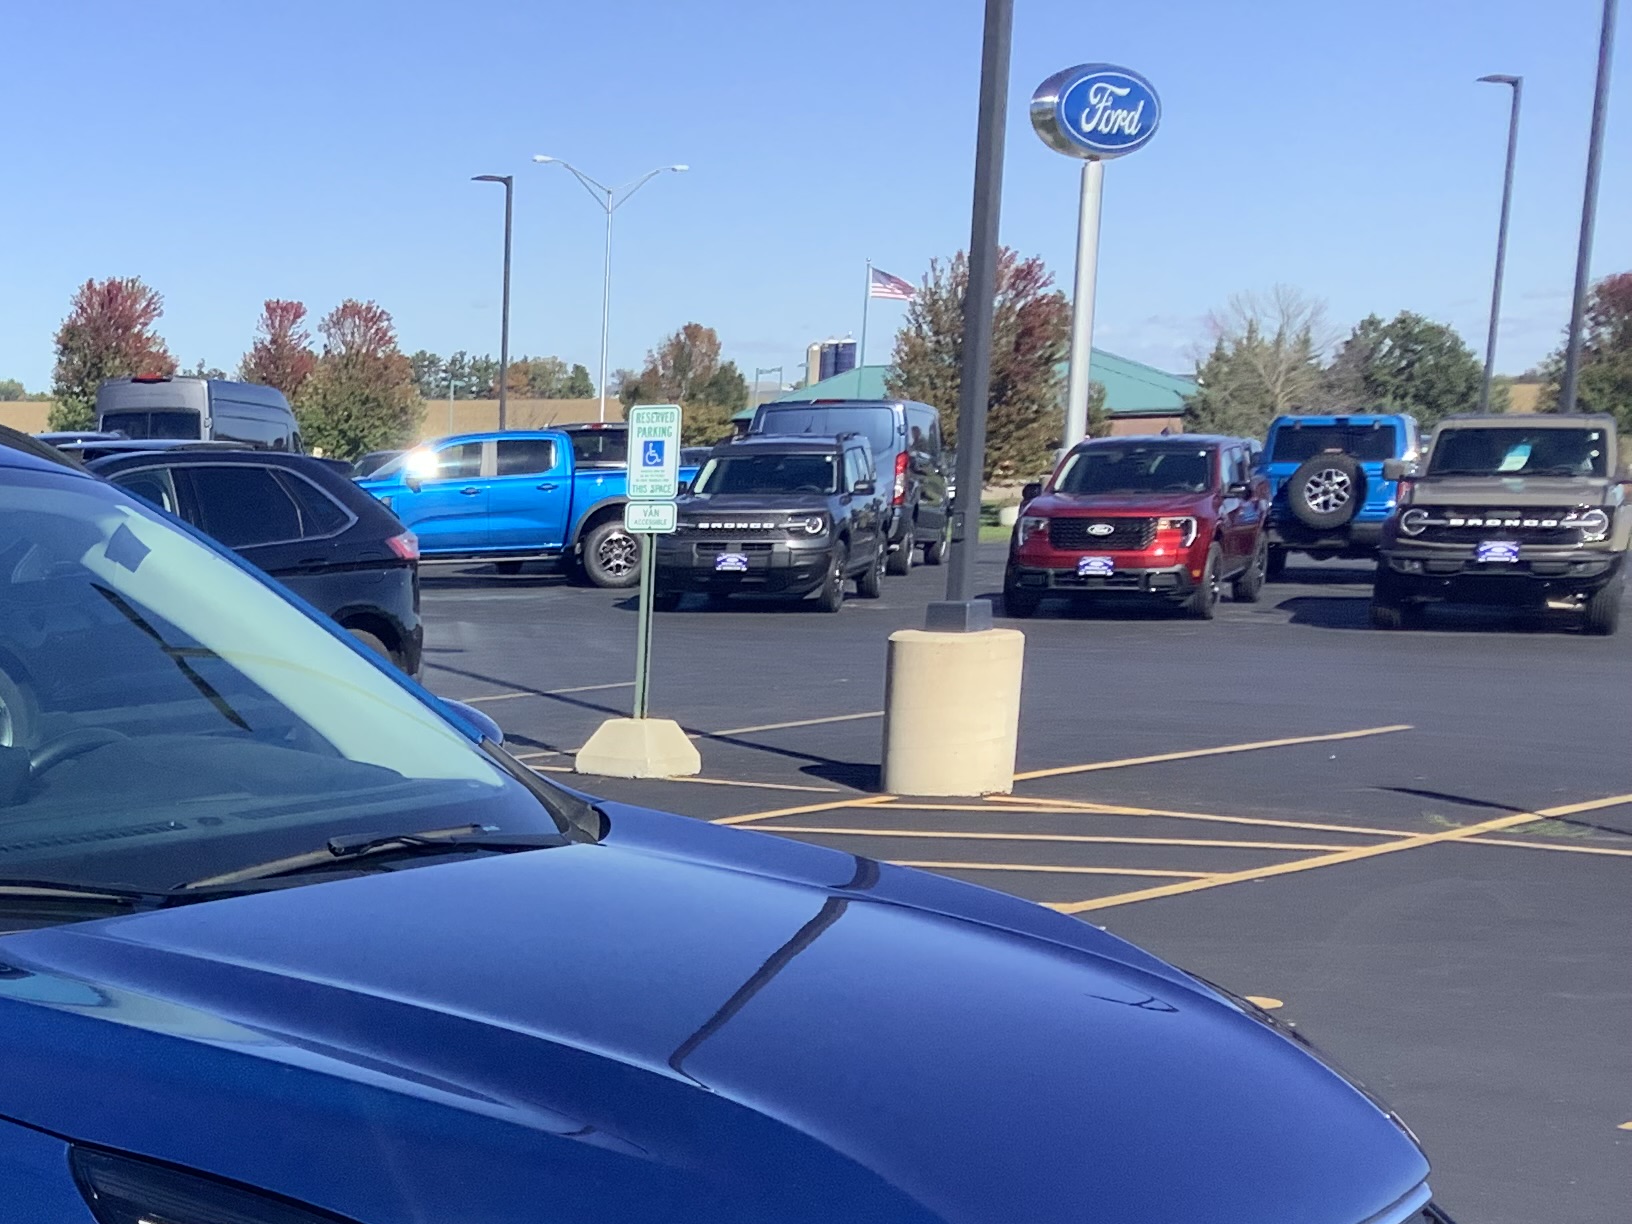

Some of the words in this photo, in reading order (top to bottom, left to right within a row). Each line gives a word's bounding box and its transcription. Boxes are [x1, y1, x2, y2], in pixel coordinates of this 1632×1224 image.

[1081, 82, 1145, 136] Ford
[636, 411, 675, 424] RESERVED
[636, 426, 673, 438] PARKING
[632, 484, 648, 493] THIS
[649, 484, 672, 493] SPACE
[643, 508, 660, 517] VAN
